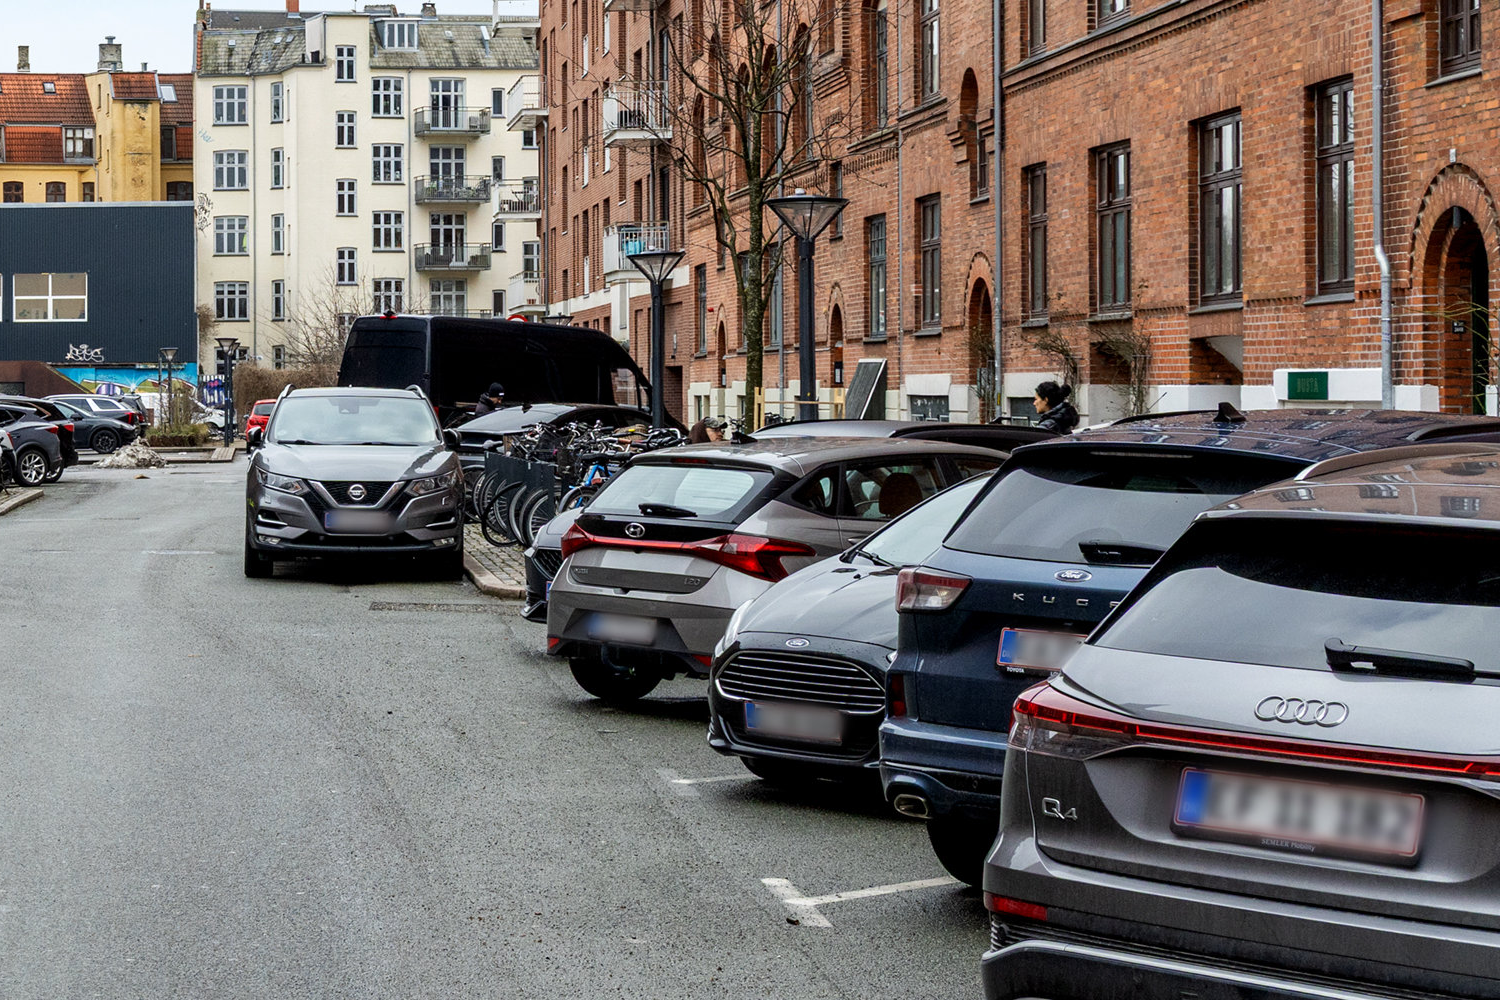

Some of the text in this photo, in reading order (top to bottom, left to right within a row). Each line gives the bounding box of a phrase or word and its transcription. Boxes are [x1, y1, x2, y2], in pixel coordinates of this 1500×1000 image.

[1041, 796, 1078, 820] Q4
[1261, 838, 1316, 853] SEMLER Mobility
